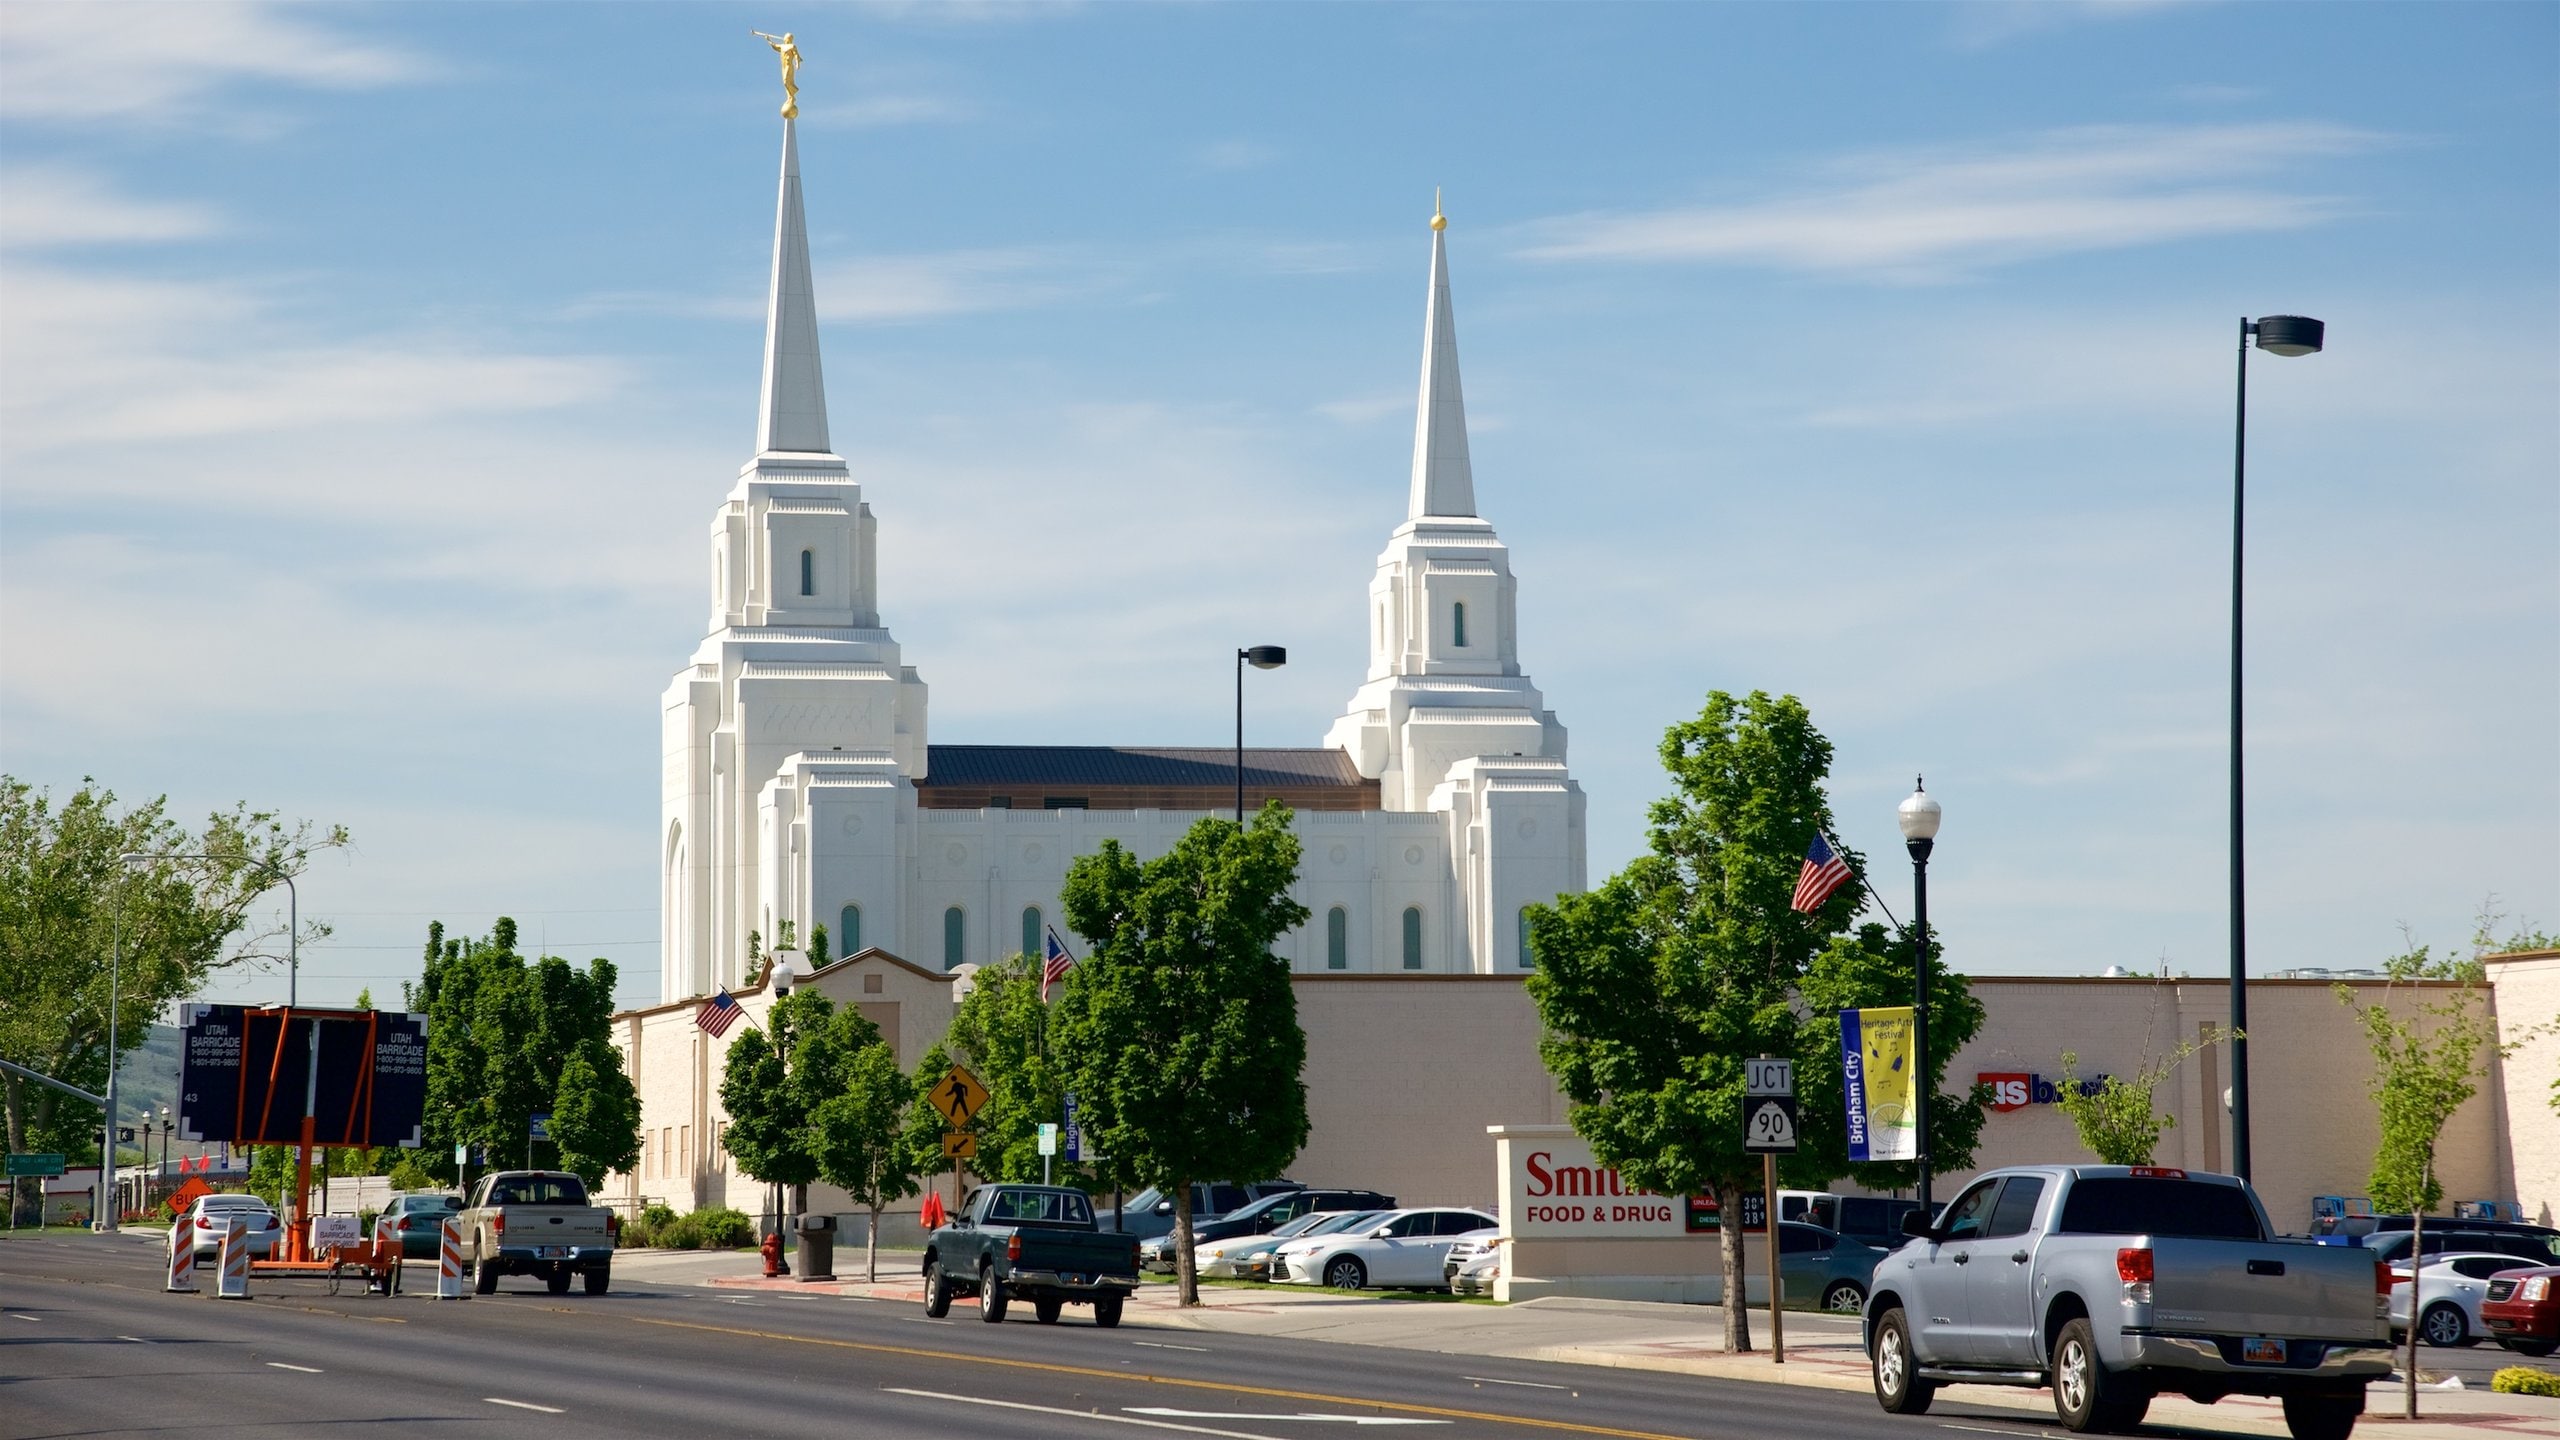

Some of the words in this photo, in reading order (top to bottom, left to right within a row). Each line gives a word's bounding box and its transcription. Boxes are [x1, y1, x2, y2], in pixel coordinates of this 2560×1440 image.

[1861, 1019, 1895, 1030] Heritage
[1897, 1017, 1913, 1027] Arts
[205, 1025, 229, 1036] UTAH
[1875, 1029, 1905, 1040] Festival
[191, 1037, 241, 1048] BARRICADE
[390, 1033, 412, 1044] UTAH
[376, 1044, 424, 1057] BARRICADE
[1845, 1050, 1861, 1080] City
[1750, 1065, 1788, 1089] JCT
[184, 1093, 199, 1103] 43
[1848, 1082, 1866, 1145] Brigham
[1758, 1112, 1783, 1135] 90
[1526, 1151, 1665, 1198] Smit
[1693, 1199, 1718, 1207] UNLEA
[1527, 1206, 1585, 1222] FOOD
[1592, 1206, 1606, 1223] &
[1612, 1206, 1672, 1223] DRUG
[1699, 1215, 1721, 1224] DIESEL
[329, 1223, 347, 1231] UTAH
[319, 1231, 356, 1239] BARRICADE
